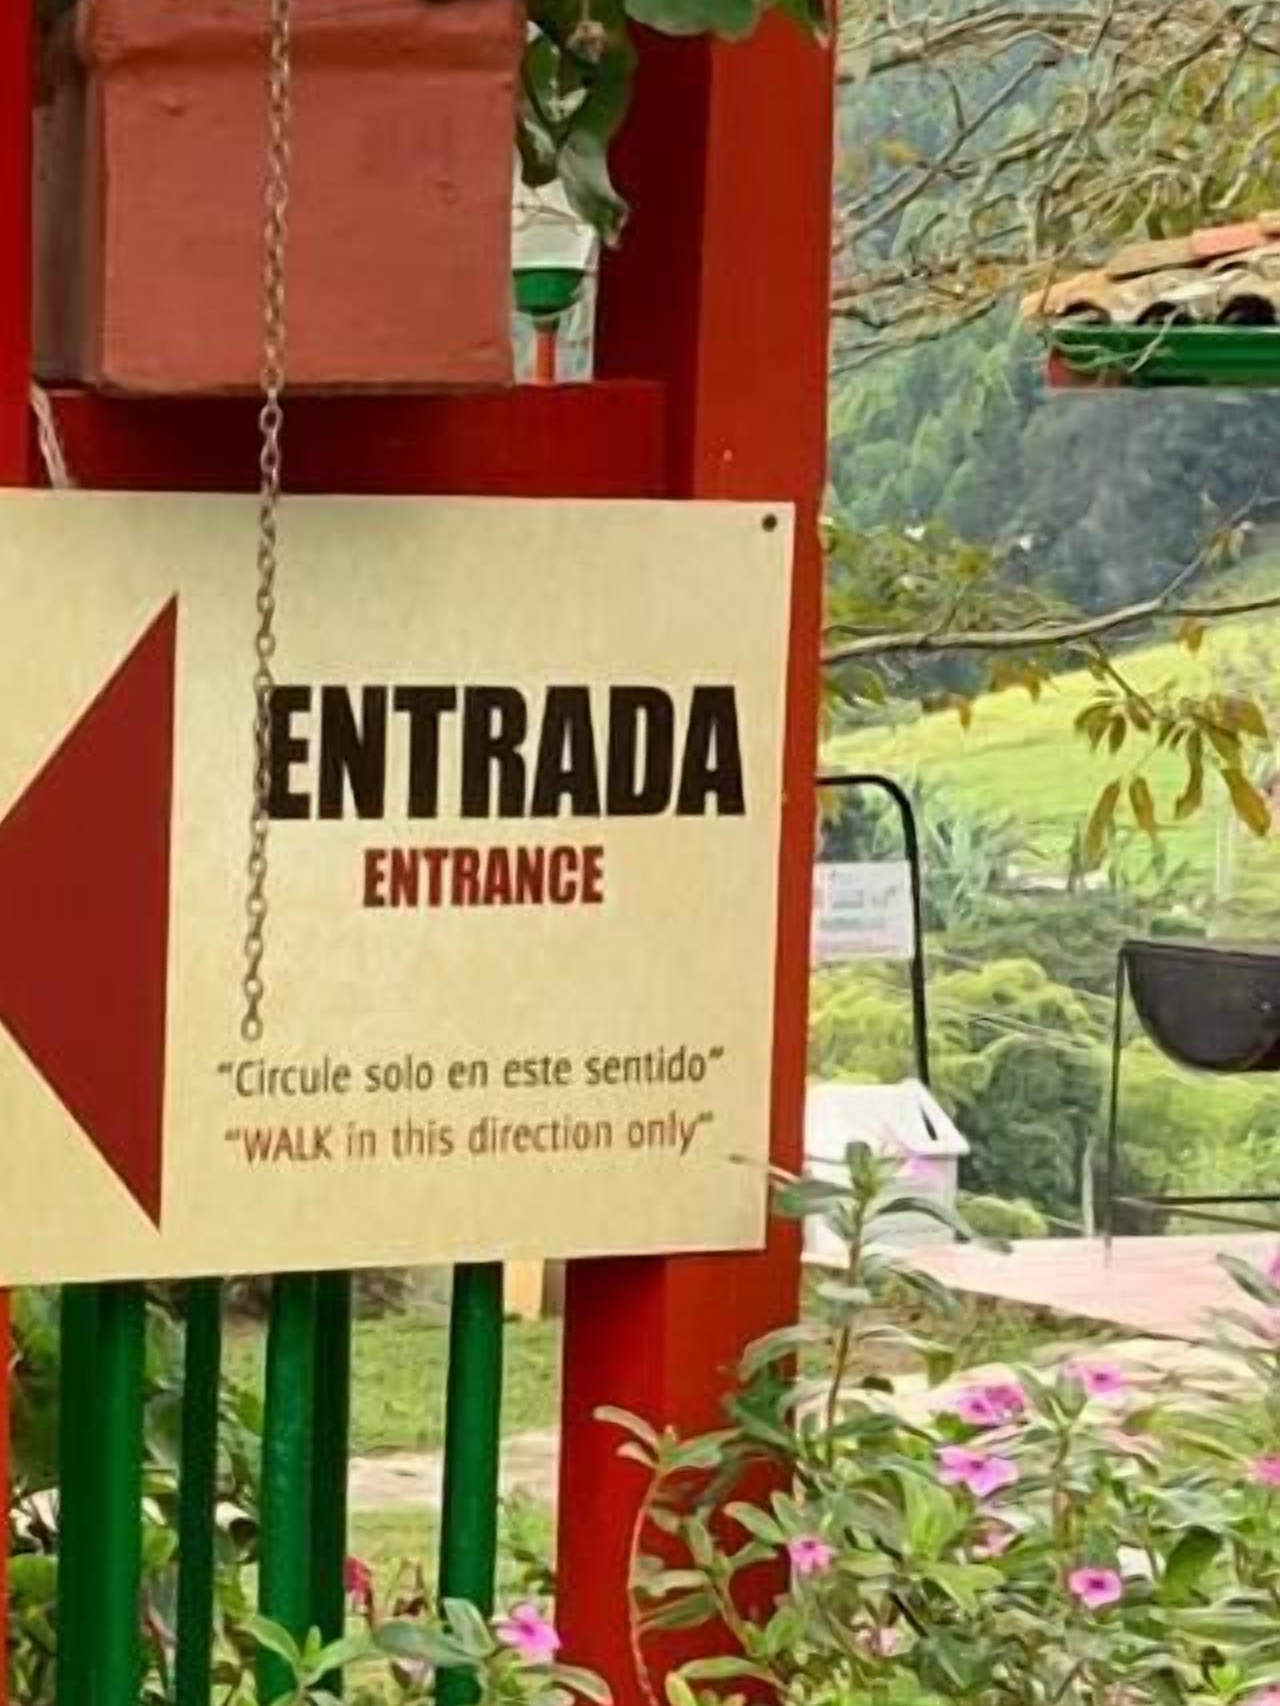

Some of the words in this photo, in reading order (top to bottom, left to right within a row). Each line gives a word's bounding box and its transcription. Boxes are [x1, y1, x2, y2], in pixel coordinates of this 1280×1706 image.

[264, 684, 746, 820] ENTRADA
[363, 845, 605, 908] ENTRANCE
[217, 1053, 352, 1097] “Circule
[364, 1053, 435, 1093] solo
[447, 1059, 489, 1090] en
[503, 1054, 573, 1089] este
[584, 1043, 725, 1086] sentido”
[224, 1123, 333, 1164] “WALK
[347, 1120, 377, 1158] in
[392, 1116, 455, 1159] this
[468, 1114, 614, 1156] direction
